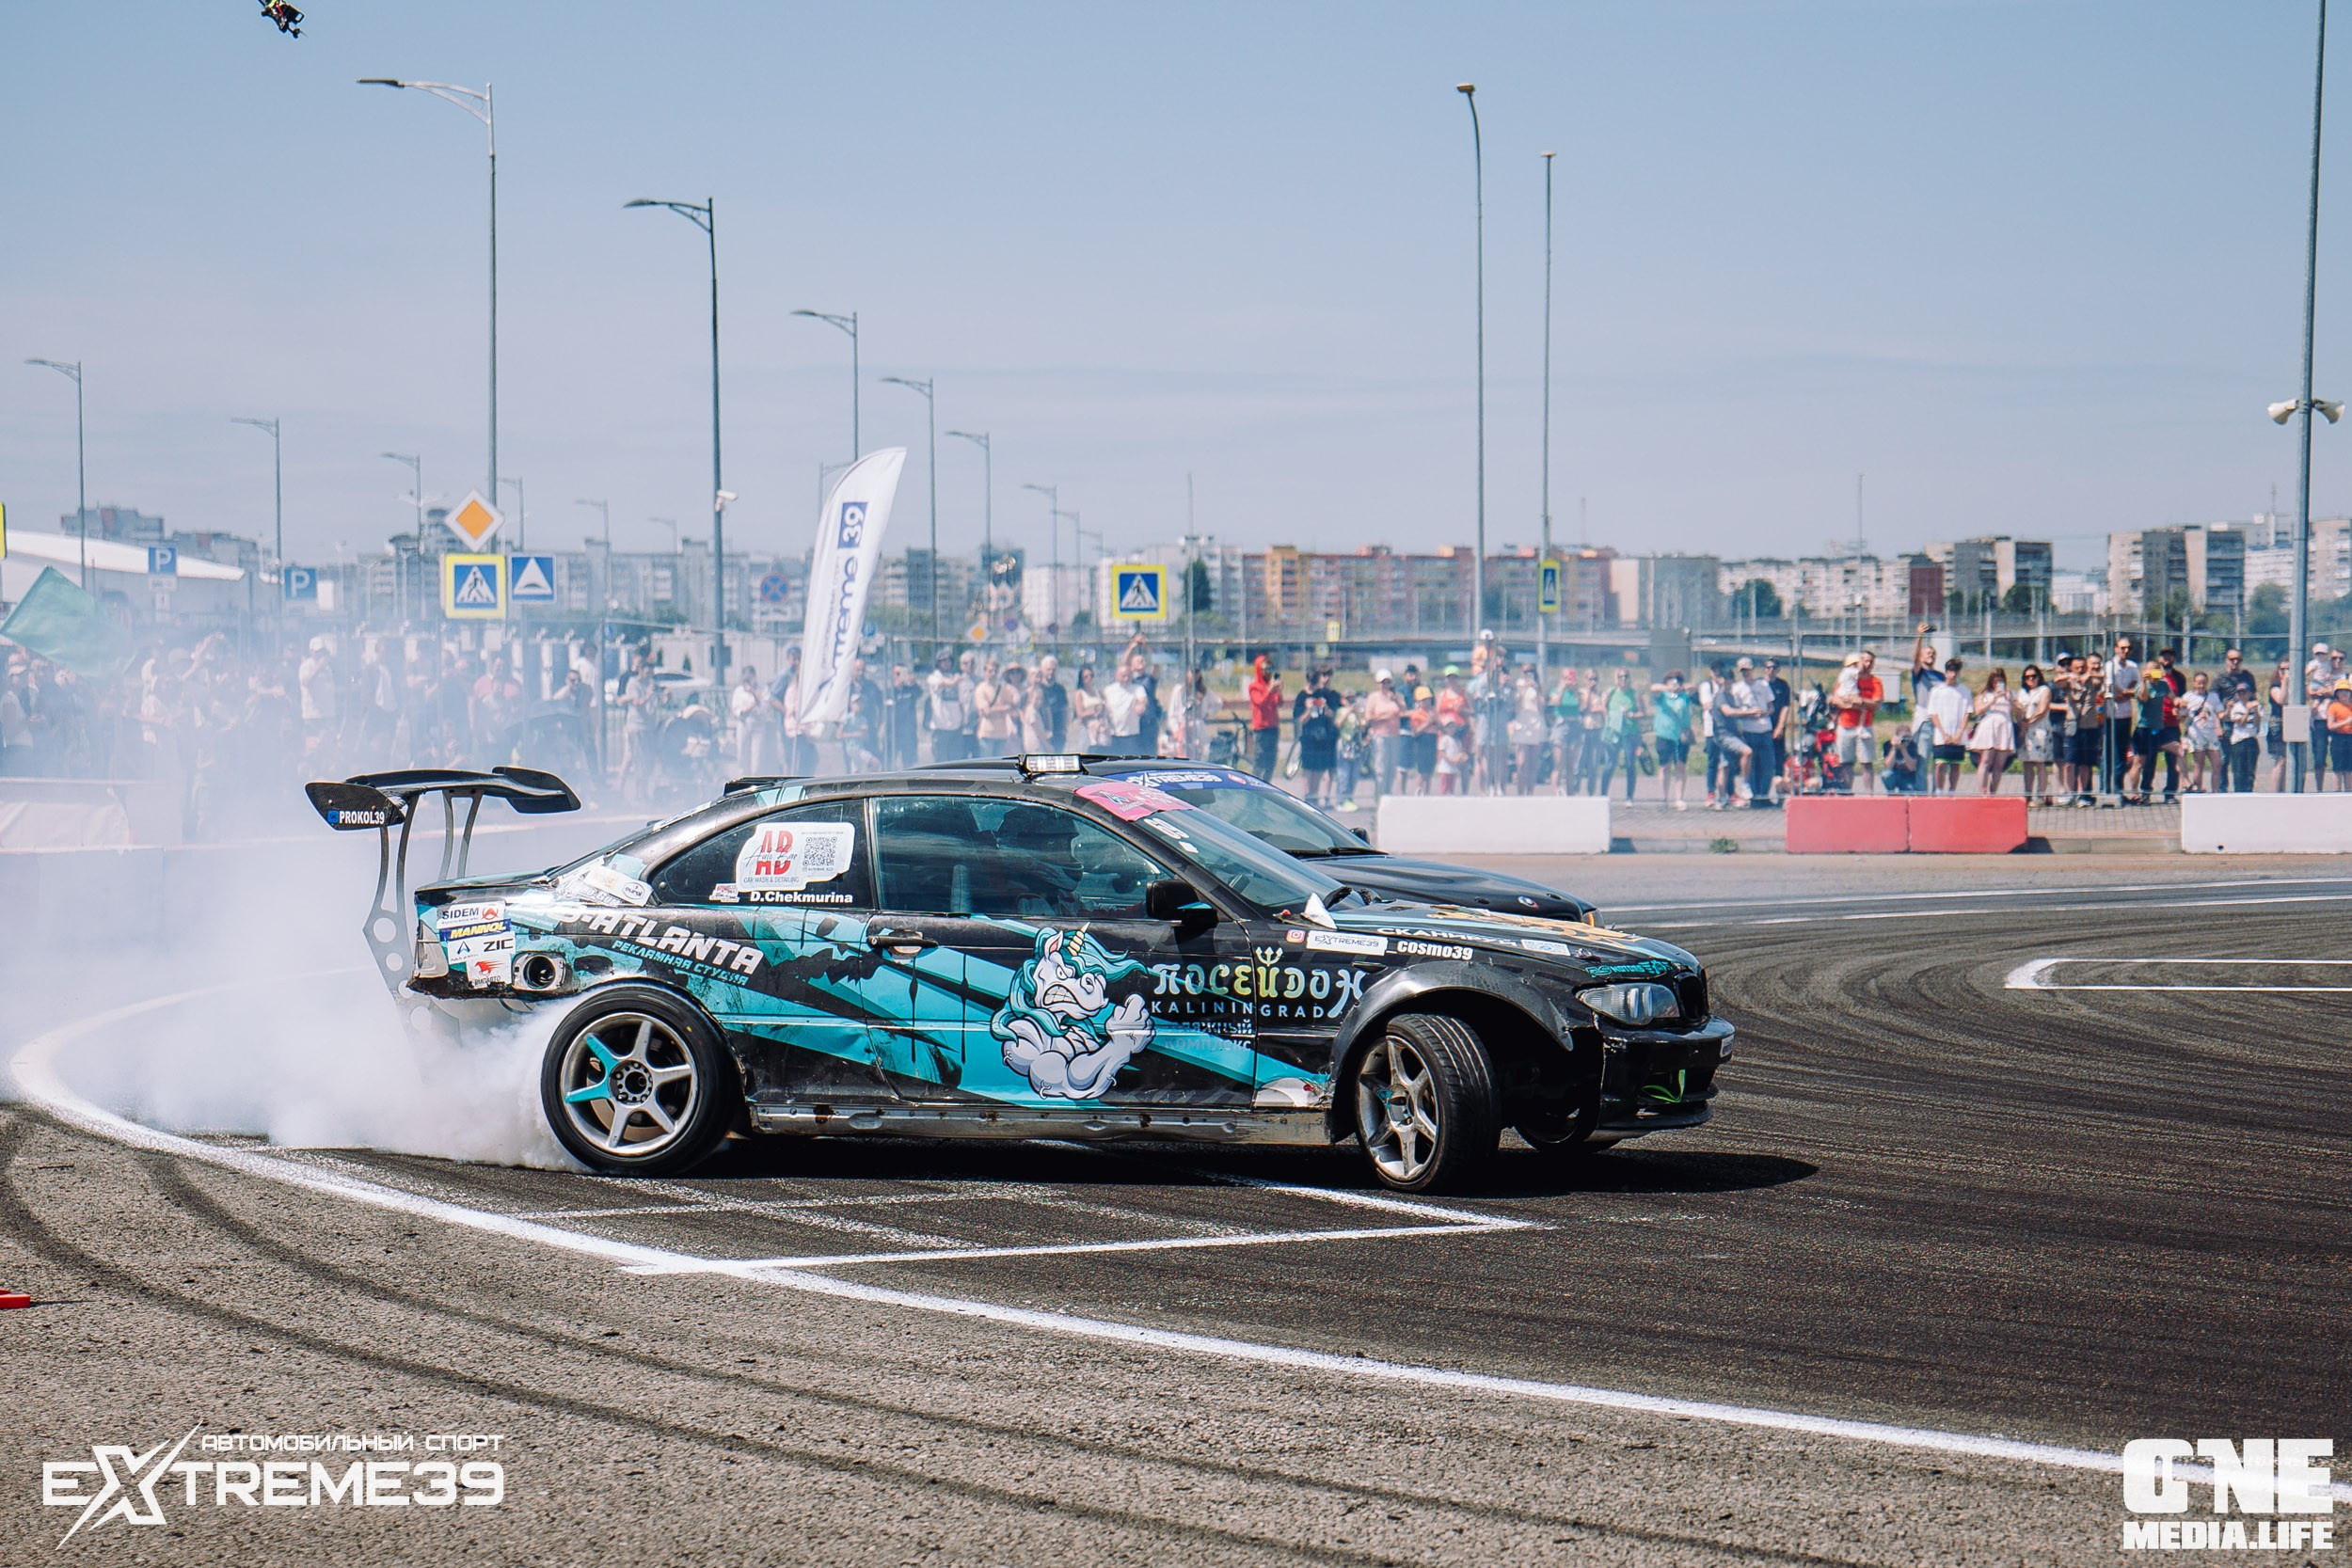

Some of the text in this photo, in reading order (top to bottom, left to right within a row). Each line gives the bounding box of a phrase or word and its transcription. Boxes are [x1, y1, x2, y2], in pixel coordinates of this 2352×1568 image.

[843, 505, 864, 546] 39
[155, 548, 171, 572] P
[291, 570, 310, 596] P
[340, 811, 385, 824] PROKOL39
[750, 891, 852, 903] D.Chekmurina
[442, 908, 479, 920] SIDEM
[451, 922, 506, 939] MANNOL
[484, 938, 514, 952] ZIC
[612, 941, 749, 986] РЕКЛАМНАЯ СТУДИЯ
[1151, 1001, 1325, 1019] KALININGRAD
